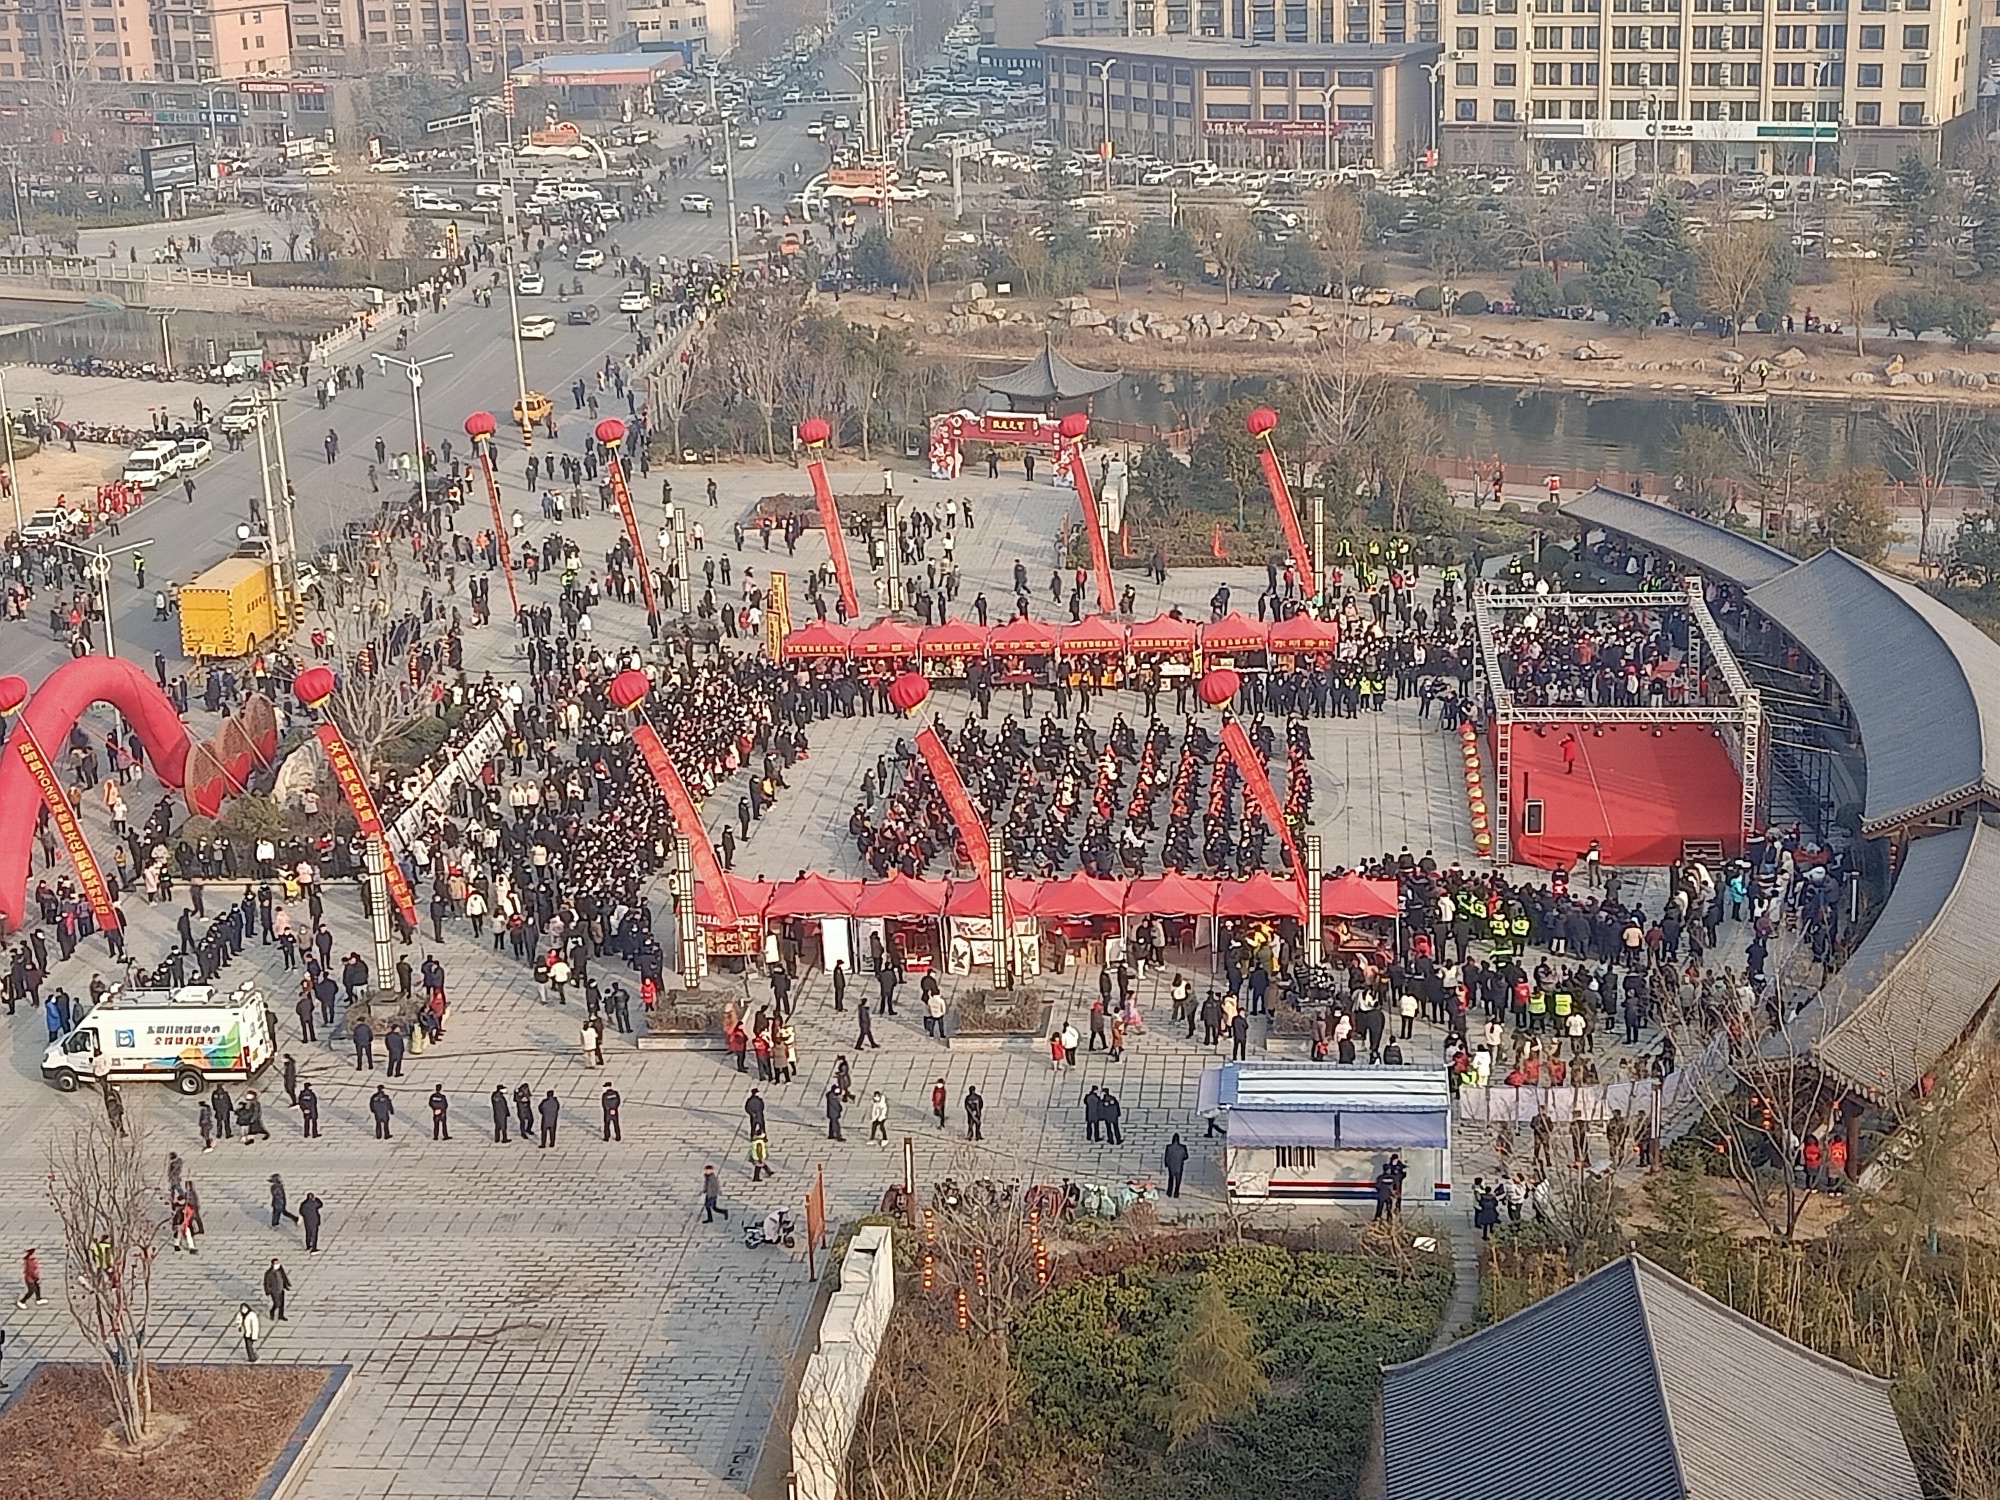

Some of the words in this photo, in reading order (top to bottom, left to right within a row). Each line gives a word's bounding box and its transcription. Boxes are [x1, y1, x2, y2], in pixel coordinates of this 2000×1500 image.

[327, 741, 375, 823] 文旅融合发展
